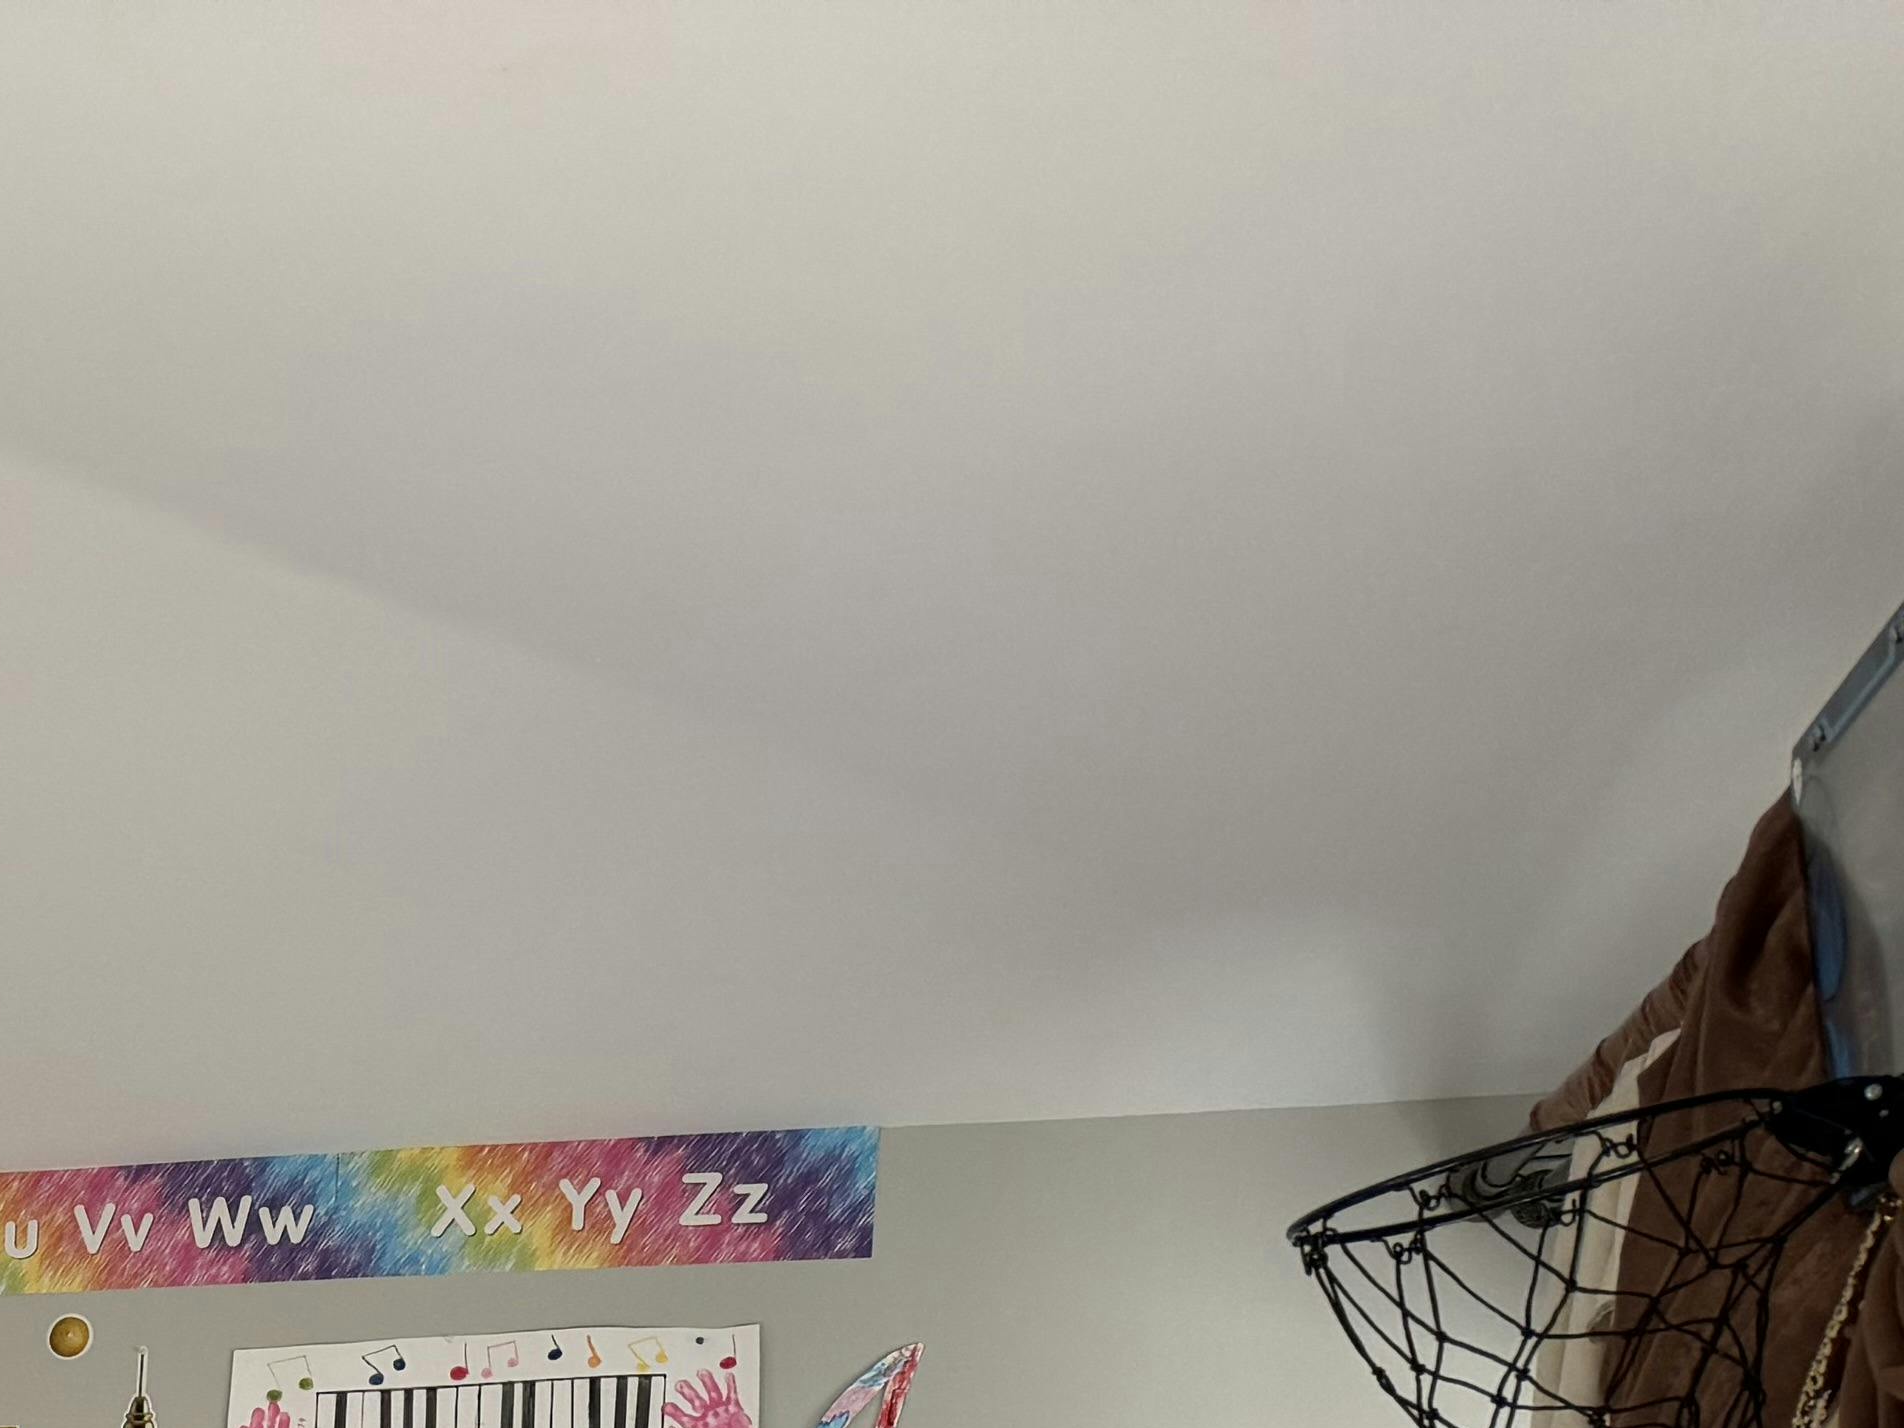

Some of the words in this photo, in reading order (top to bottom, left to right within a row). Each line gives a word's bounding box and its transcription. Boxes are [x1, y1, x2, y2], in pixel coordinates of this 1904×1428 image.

[72, 1201, 153, 1255] Vv
[189, 1195, 315, 1248] Ww
[431, 1181, 522, 1238] Xx
[558, 1176, 643, 1244] Yy
[678, 1171, 770, 1227] Zz
